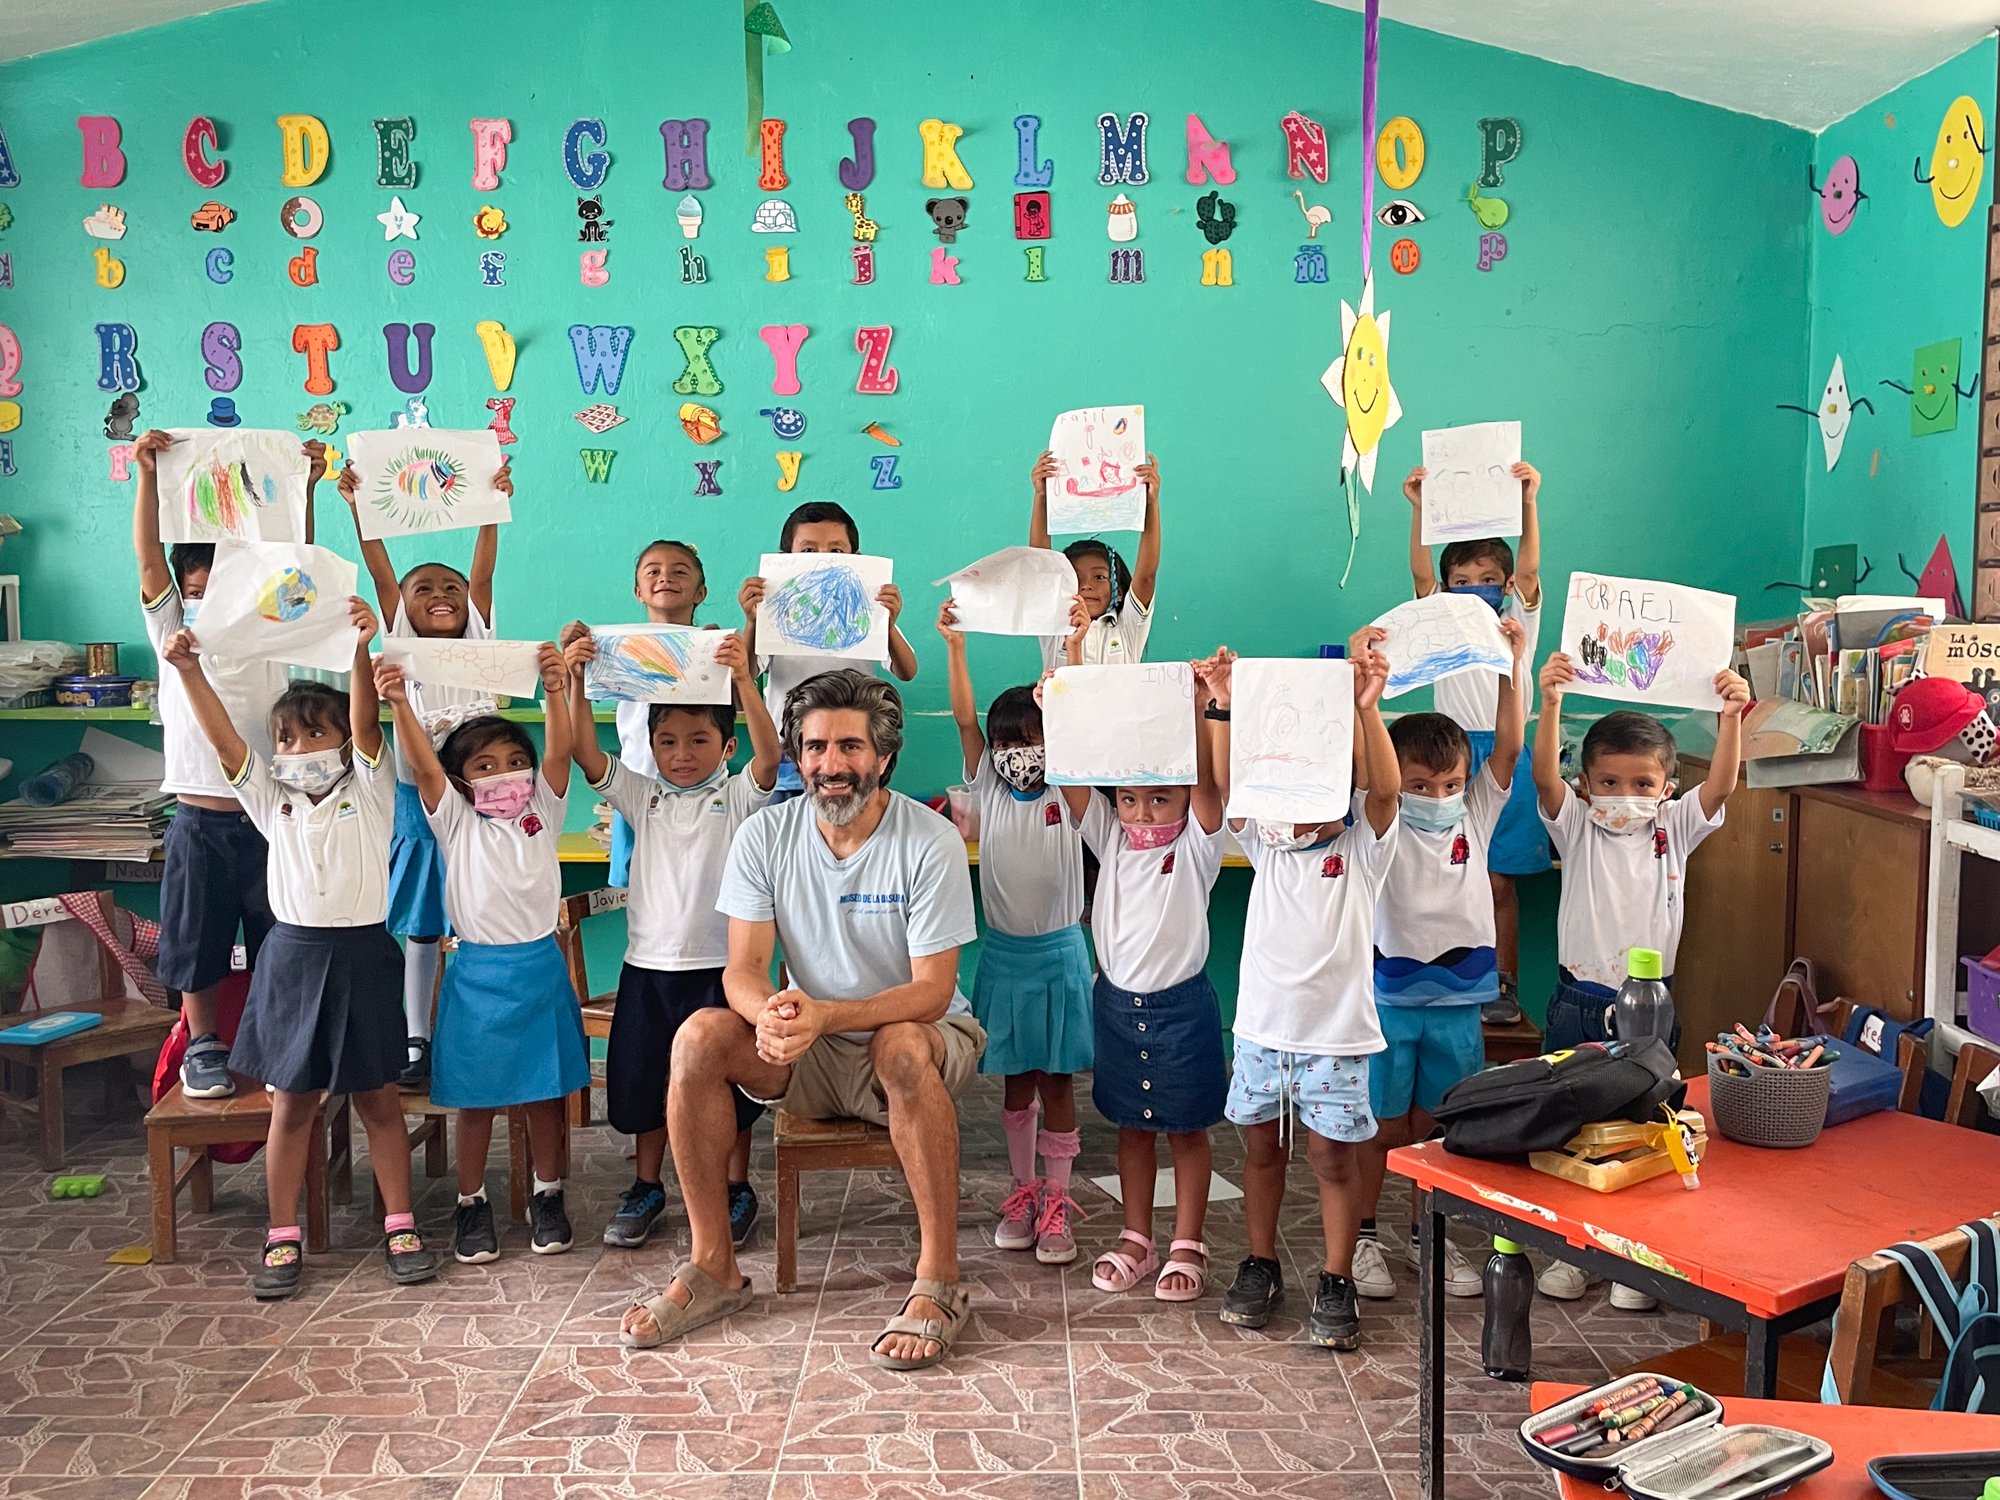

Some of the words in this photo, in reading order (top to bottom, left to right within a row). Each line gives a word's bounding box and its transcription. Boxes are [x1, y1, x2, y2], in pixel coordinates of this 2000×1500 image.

[77, 116, 126, 188] B
[182, 115, 226, 188] C
[277, 114, 329, 187] D
[373, 116, 416, 189] E
[470, 118, 512, 191] F
[562, 117, 610, 190] G
[659, 119, 711, 191] H
[759, 118, 789, 191] I
[839, 117, 876, 190] J
[918, 119, 974, 190] K
[1013, 114, 1053, 187] L
[1097, 111, 1149, 186] M
[1376, 116, 1425, 190] O
[1477, 116, 1522, 188] P
[288, 246, 319, 287] d
[388, 248, 415, 286] e
[480, 251, 507, 287] f
[678, 245, 708, 284] h
[94, 322, 140, 393] R
[201, 321, 243, 392] S
[292, 323, 338, 395] T
[382, 322, 436, 393] U
[476, 320, 516, 392] V
[568, 324, 635, 395] W
[673, 325, 723, 395] X
[759, 324, 809, 395] Y
[855, 325, 898, 394] Z
[1950, 632, 1966, 644] LA
[11, 903, 70, 925] Dere
[862, 894, 872, 903] DE
[872, 894, 881, 903] LA
